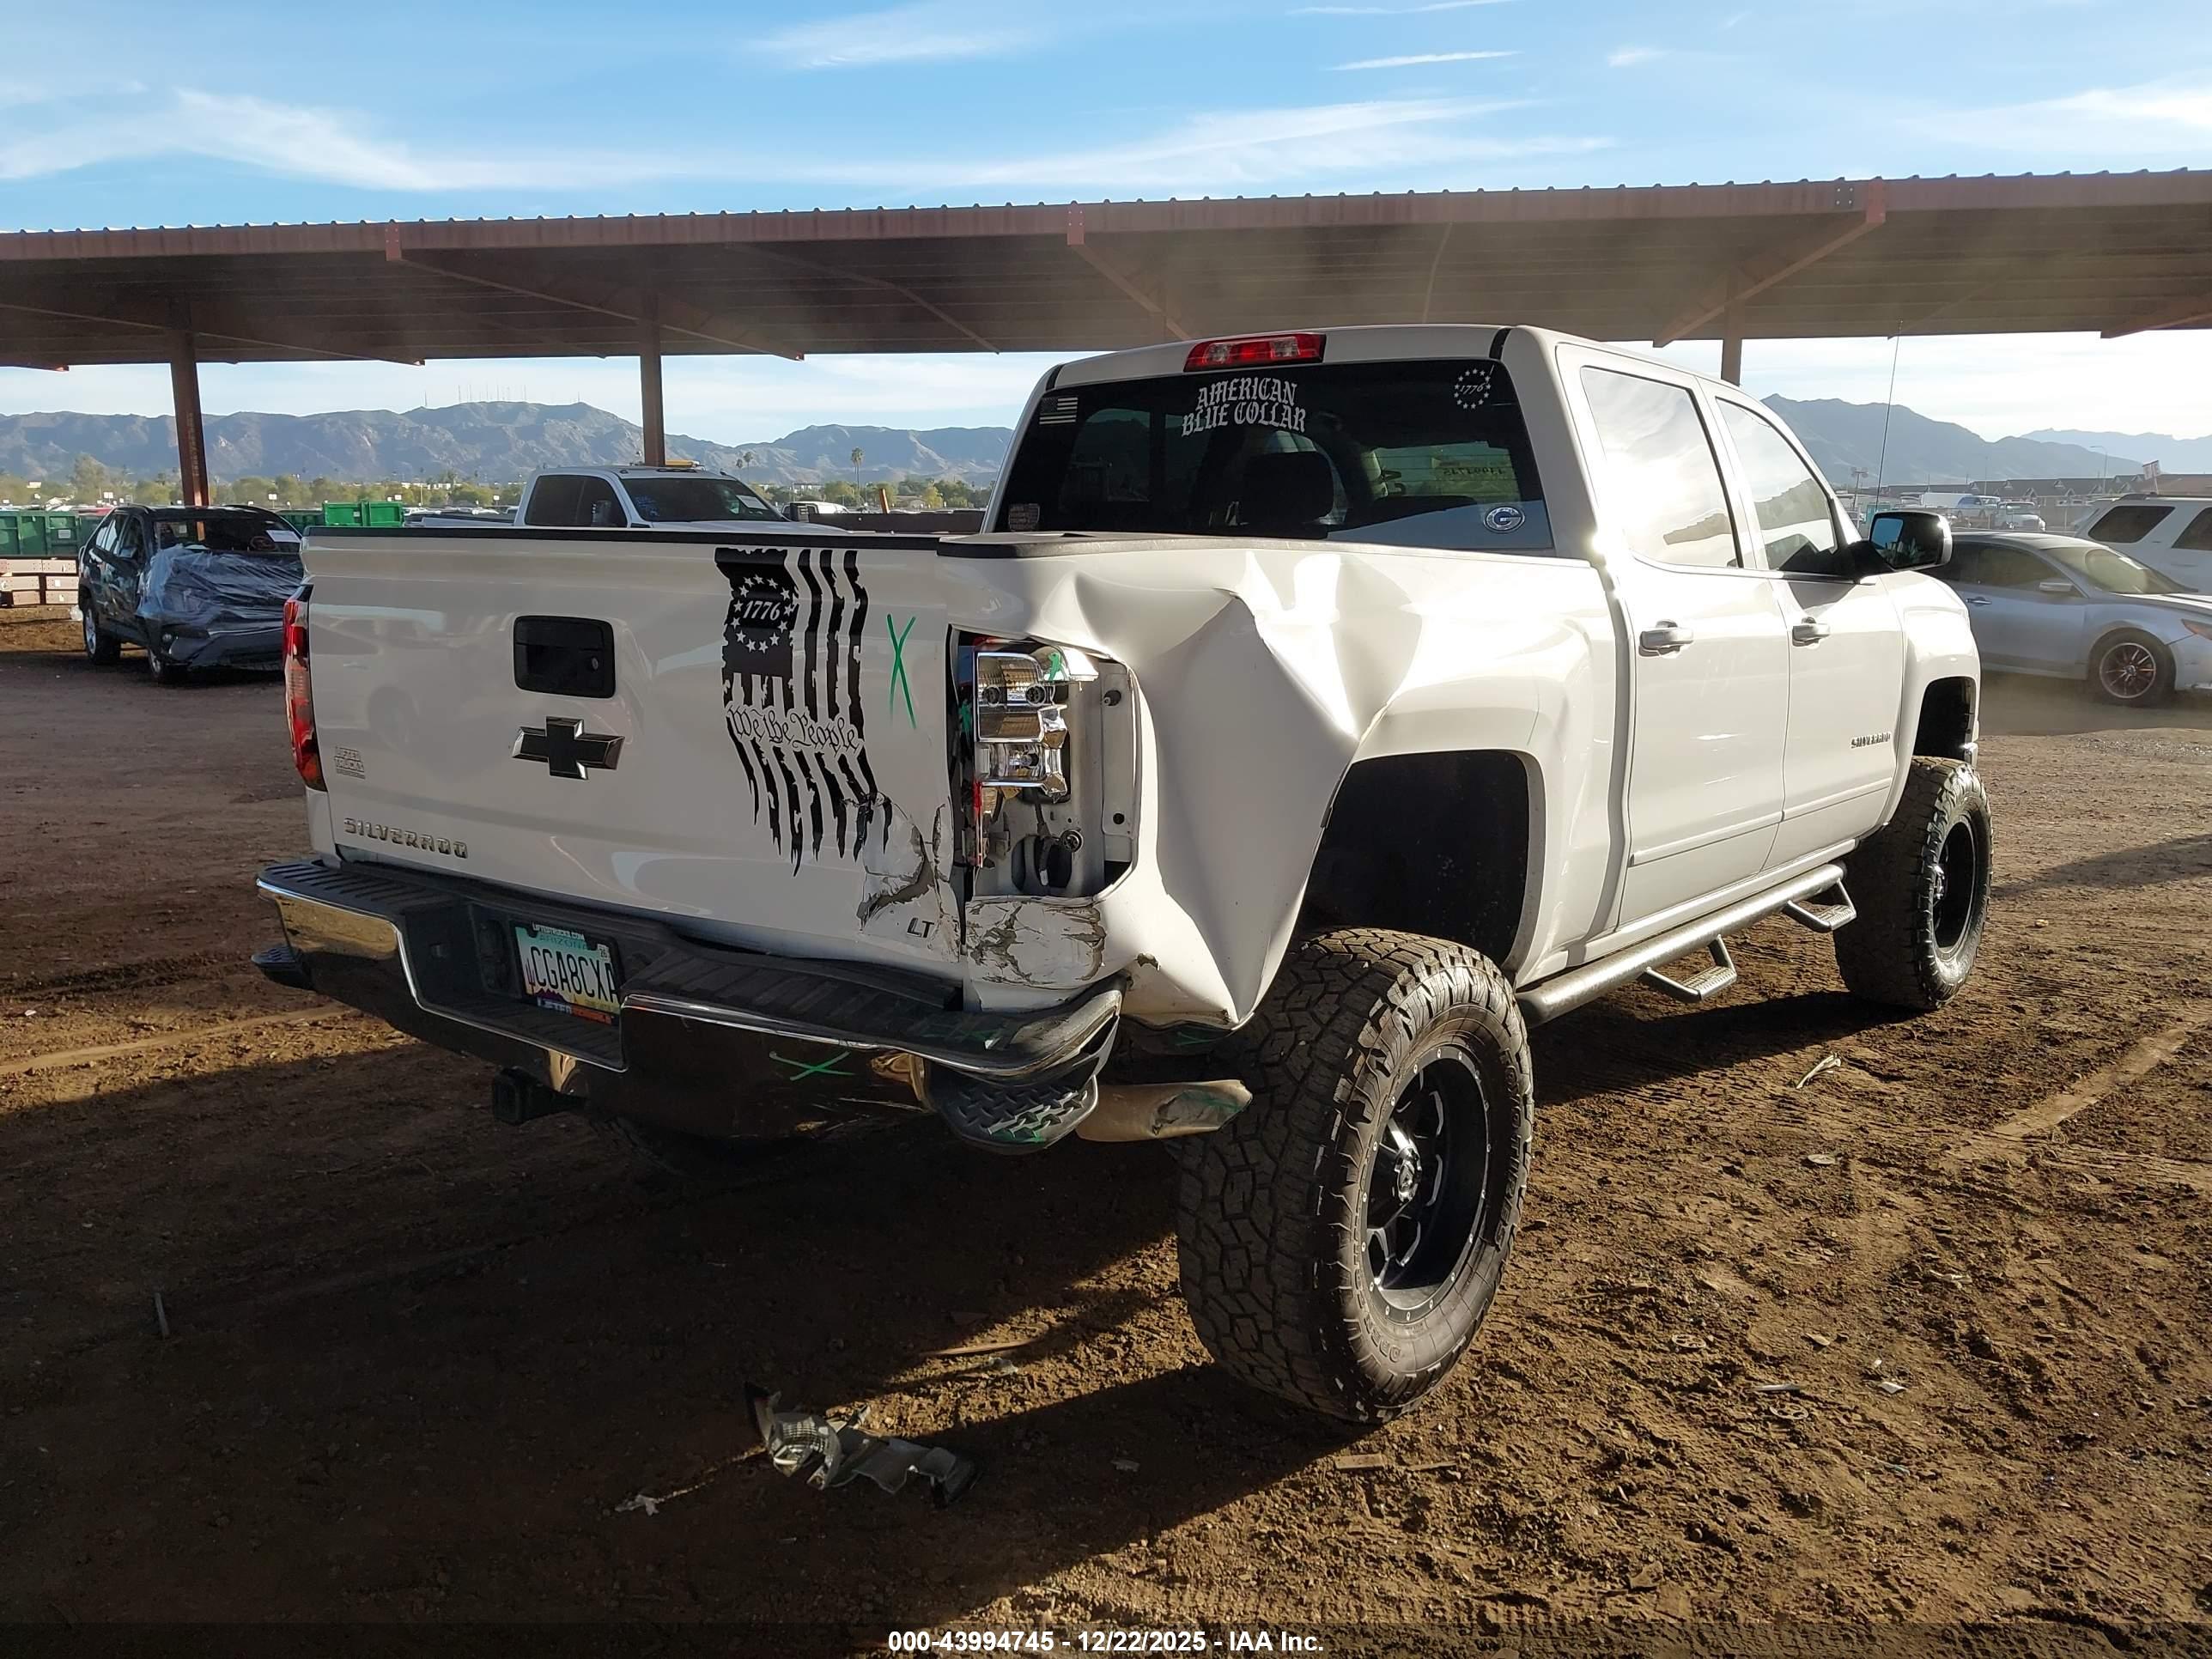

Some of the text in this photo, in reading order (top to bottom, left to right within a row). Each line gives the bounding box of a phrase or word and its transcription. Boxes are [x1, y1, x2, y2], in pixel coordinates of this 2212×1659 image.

[1195, 376, 1297, 410] AMERICAN
[1460, 382, 1486, 395] 1776
[1181, 401, 1307, 437] BLUE COLLAR
[743, 600, 781, 621] 1776
[727, 705, 766, 742] We
[789, 712, 860, 758] People
[1850, 732, 1891, 749] SILVERADO
[343, 817, 469, 860] SILVERADO
[907, 917, 935, 939] LT
[530, 945, 619, 1004] CGA8CXA
